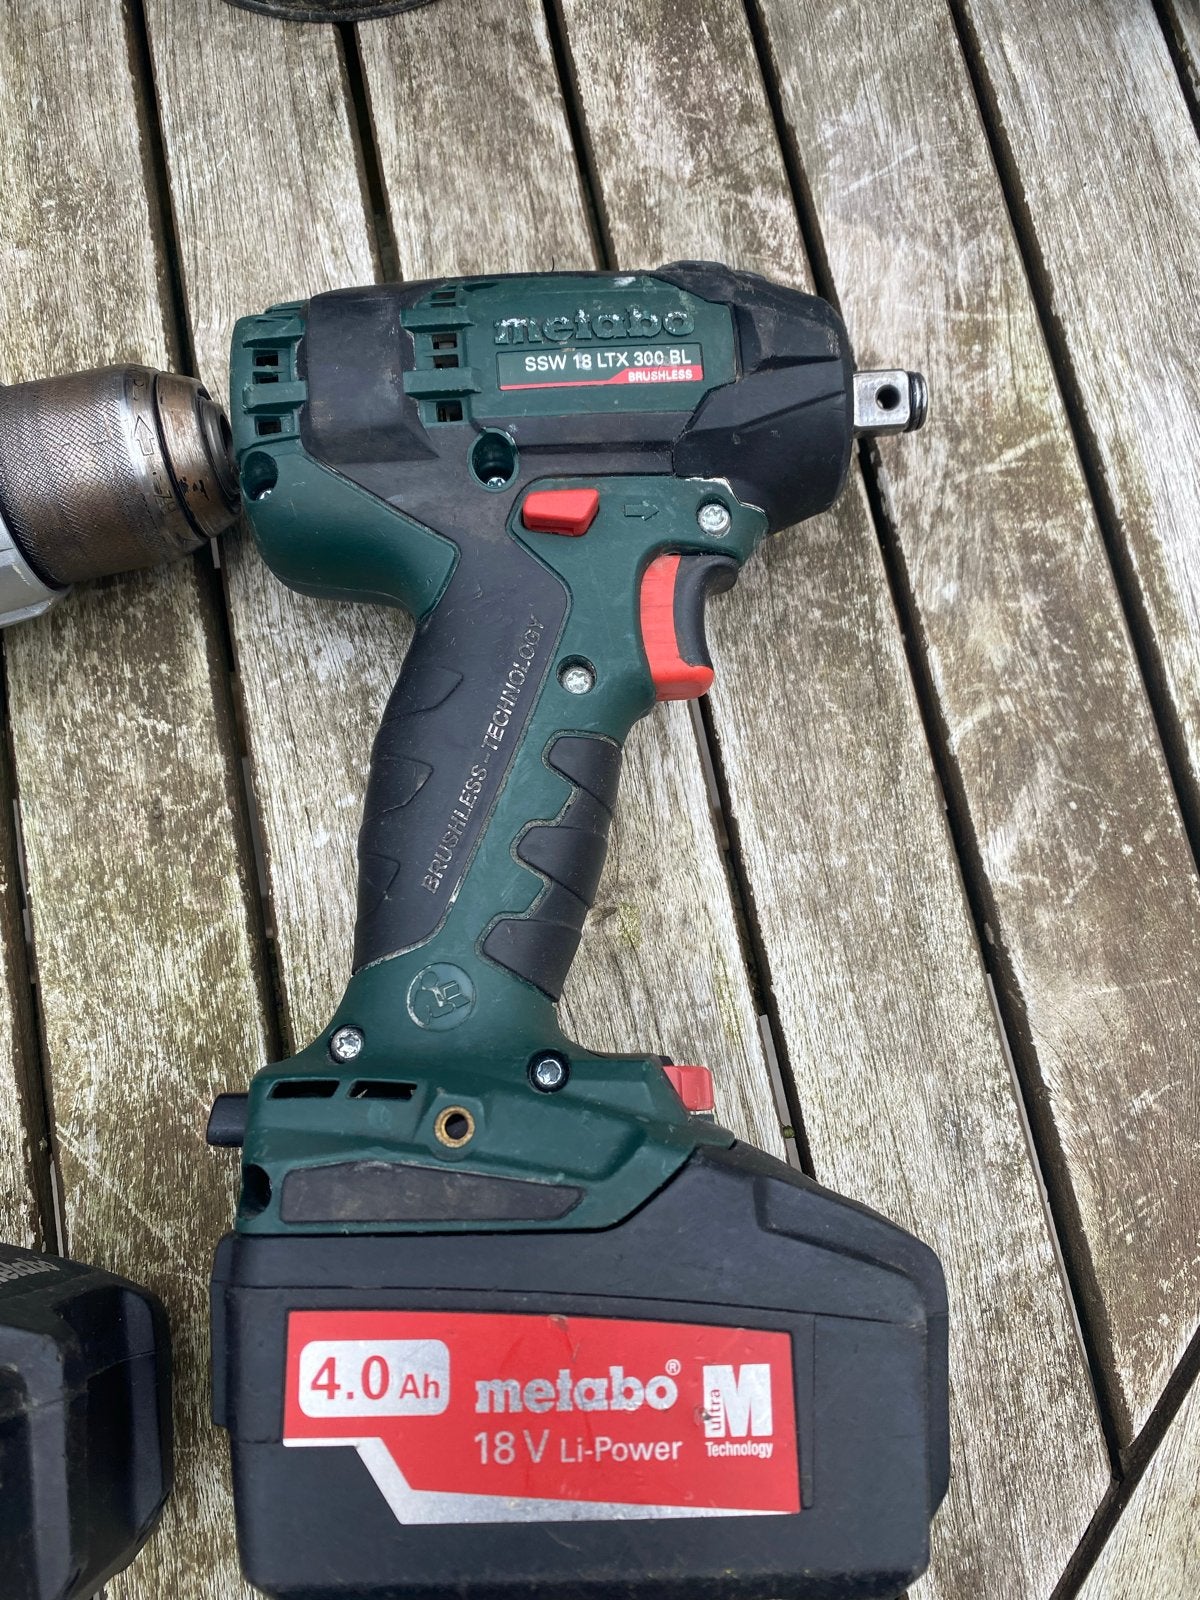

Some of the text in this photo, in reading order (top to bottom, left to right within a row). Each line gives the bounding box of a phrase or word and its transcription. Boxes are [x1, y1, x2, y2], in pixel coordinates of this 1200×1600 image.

[494, 308, 695, 345] metabo
[525, 349, 691, 372] SSW 18 LTX 300 BL
[628, 369, 693, 382] BRUSHLESS
[0, 1255, 61, 1284] etabo
[311, 1355, 440, 1400] 4.0 Ah
[710, 1389, 721, 1431] ultra
[474, 1429, 683, 1465] 18 V Li-Power
[705, 1440, 773, 1459] Technology
